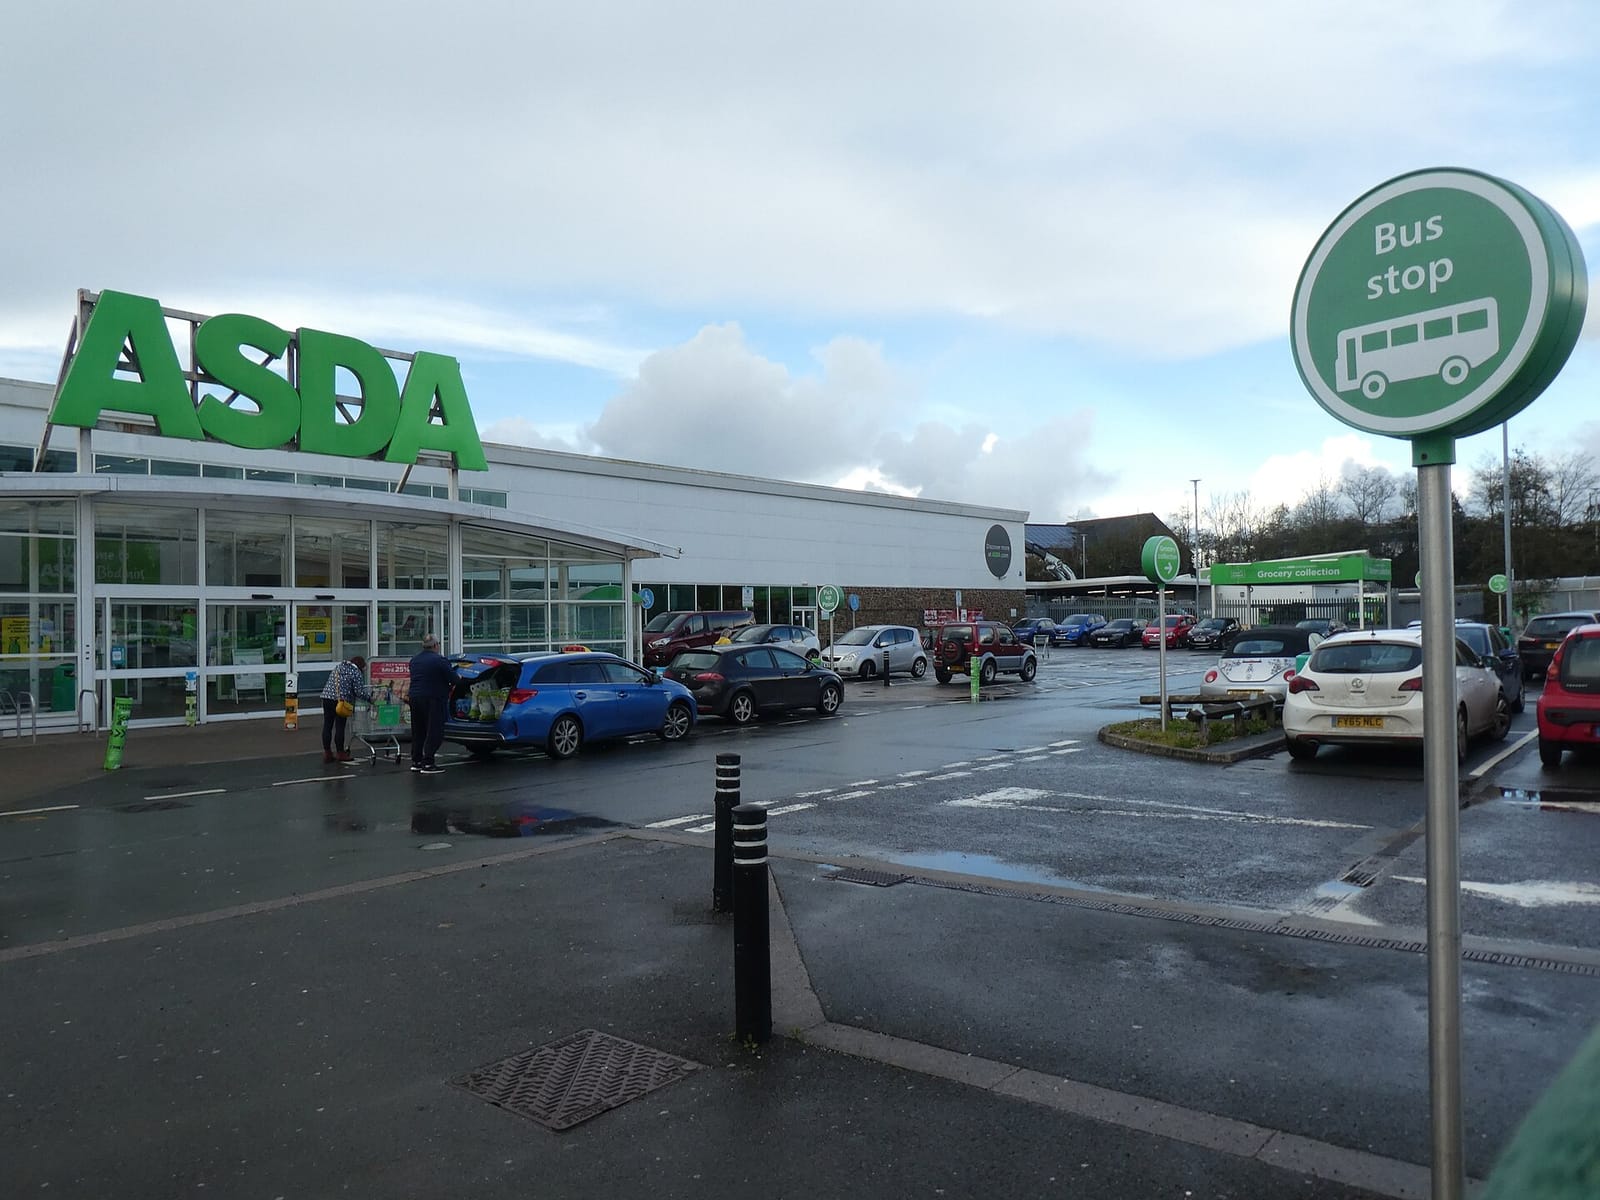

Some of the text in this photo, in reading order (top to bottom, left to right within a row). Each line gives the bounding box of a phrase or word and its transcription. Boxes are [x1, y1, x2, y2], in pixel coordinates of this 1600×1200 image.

[1375, 215, 1444, 255] Bus
[1367, 257, 1454, 300] stop
[48, 288, 489, 471] ASDA
[1257, 569, 1292, 578] Grocery
[1295, 567, 1340, 577] collection
[287, 679, 294, 688] 2
